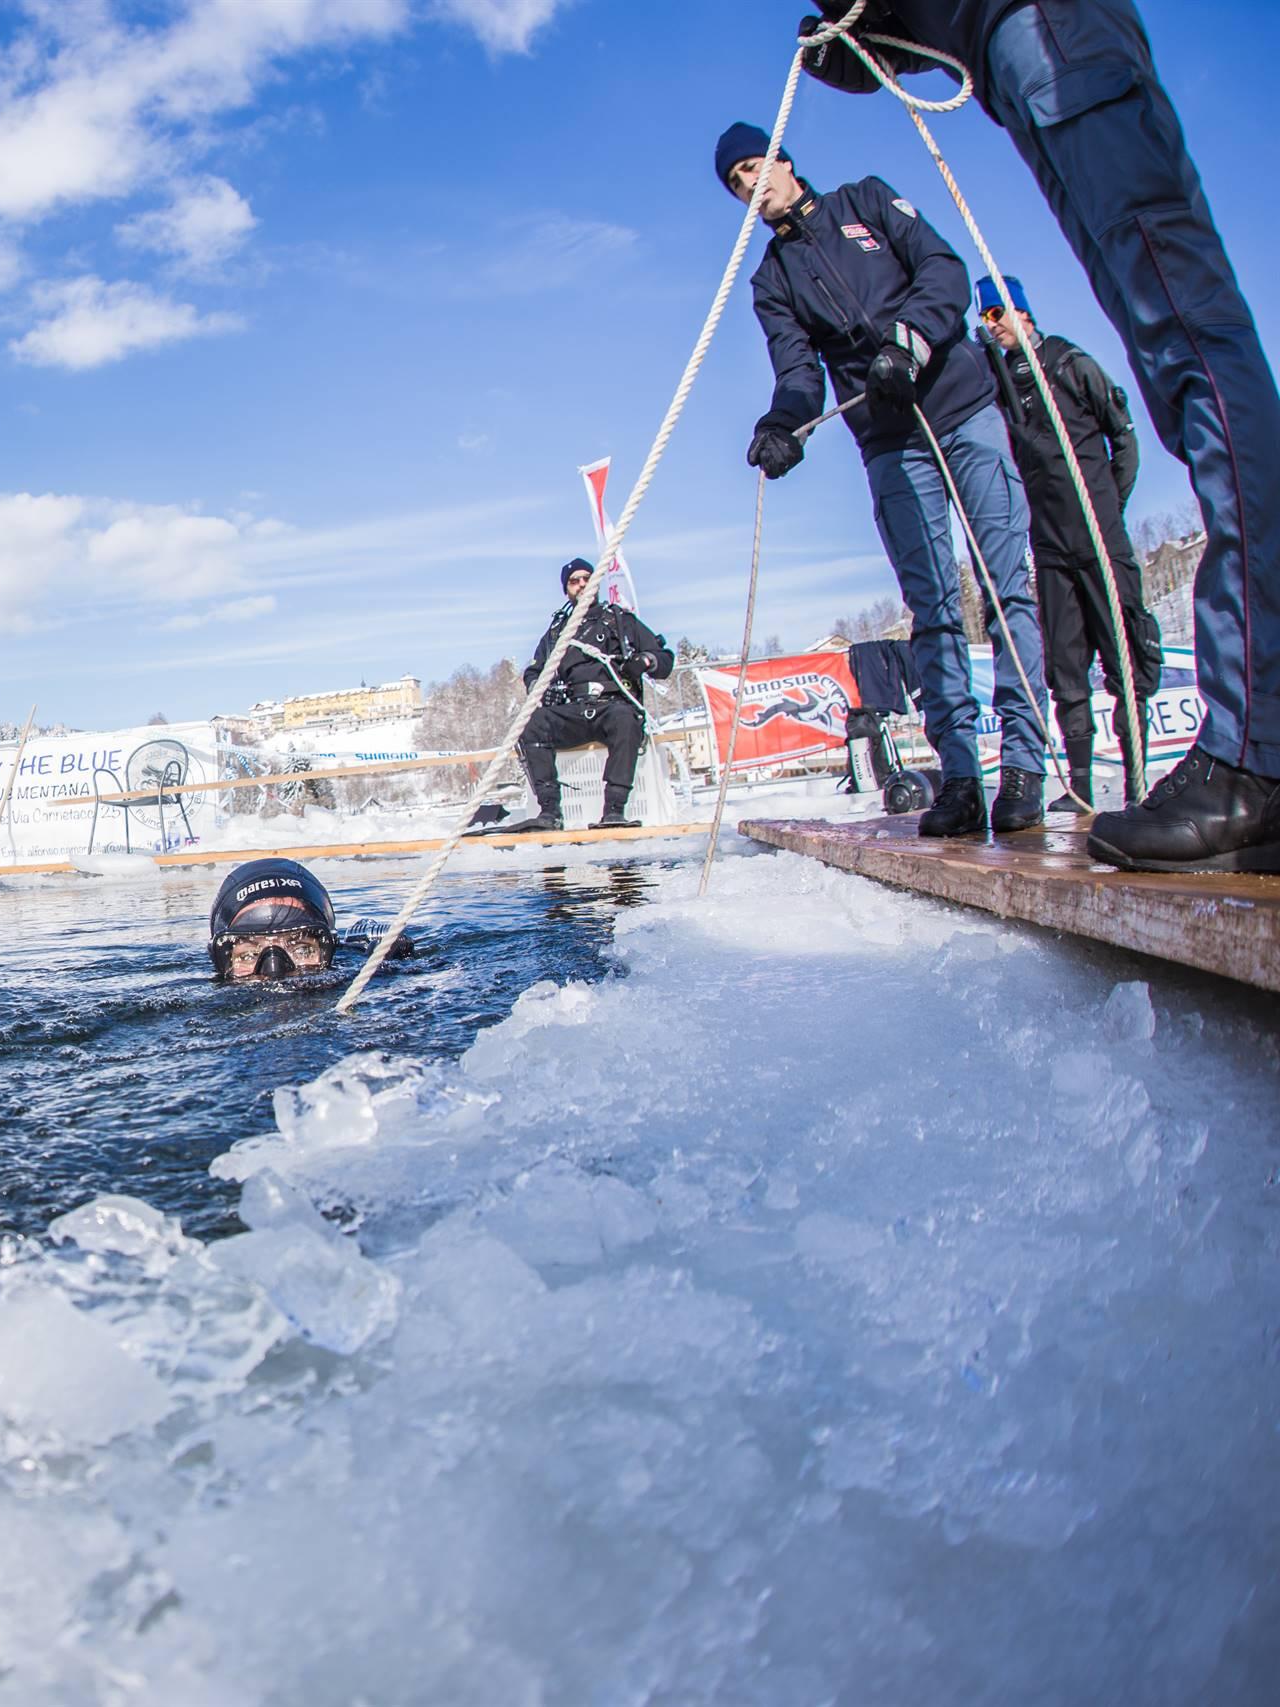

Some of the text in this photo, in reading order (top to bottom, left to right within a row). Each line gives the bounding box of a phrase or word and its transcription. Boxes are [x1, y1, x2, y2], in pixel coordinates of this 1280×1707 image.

[10, 754, 53, 776] HE
[60, 749, 123, 774] BLUE
[354, 751, 418, 761] SHIMANO
[17, 782, 90, 800] MENTANA
[100, 806, 121, 819] 25
[236, 879, 276, 901] mares
